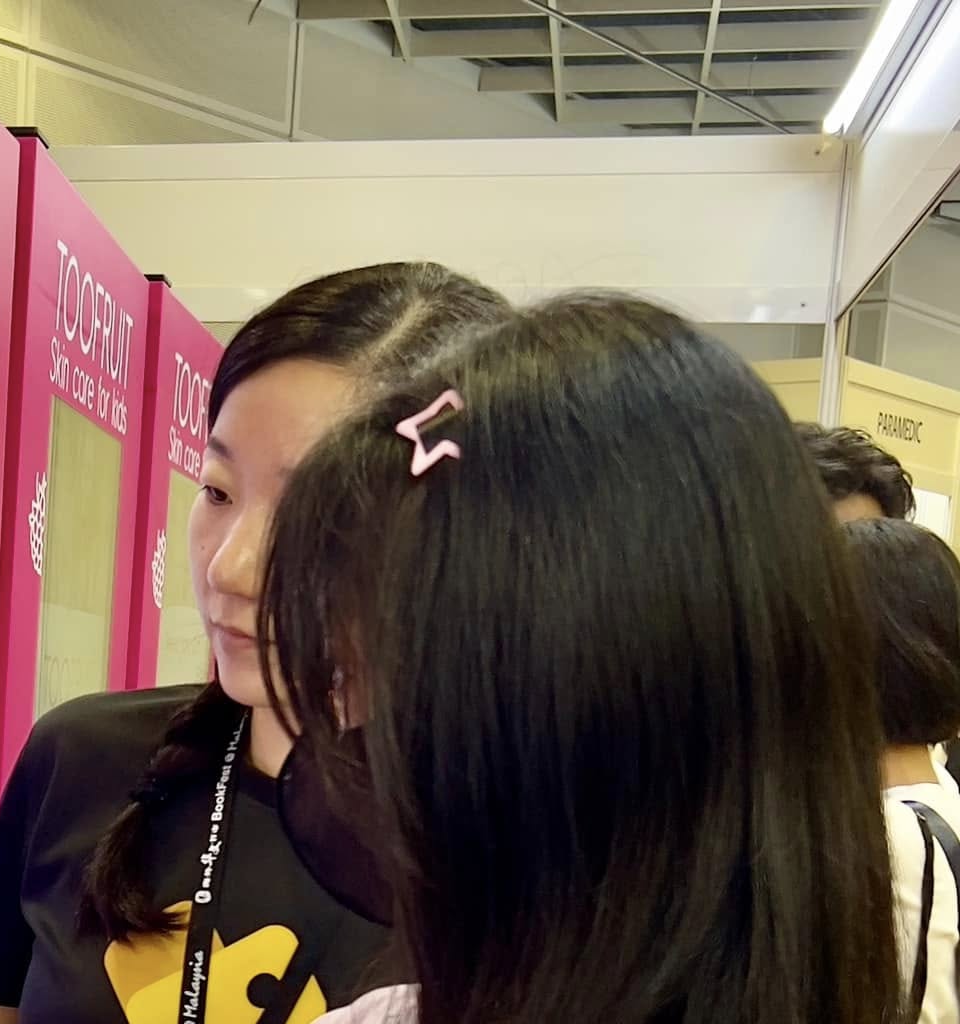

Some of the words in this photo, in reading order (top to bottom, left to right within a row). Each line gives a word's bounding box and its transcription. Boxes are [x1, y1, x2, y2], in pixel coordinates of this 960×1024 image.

[55, 239, 134, 390] TOOFRUIT
[49, 336, 70, 393] Skin
[72, 365, 95, 411] care
[97, 375, 110, 422] for
[111, 388, 128, 436] kids
[167, 425, 183, 467] Skin
[183, 446, 201, 478] care
[876, 412, 924, 444] PARAMEDIC
[211, 765, 232, 821] BookFest
[183, 950, 206, 1018] Malaysia
